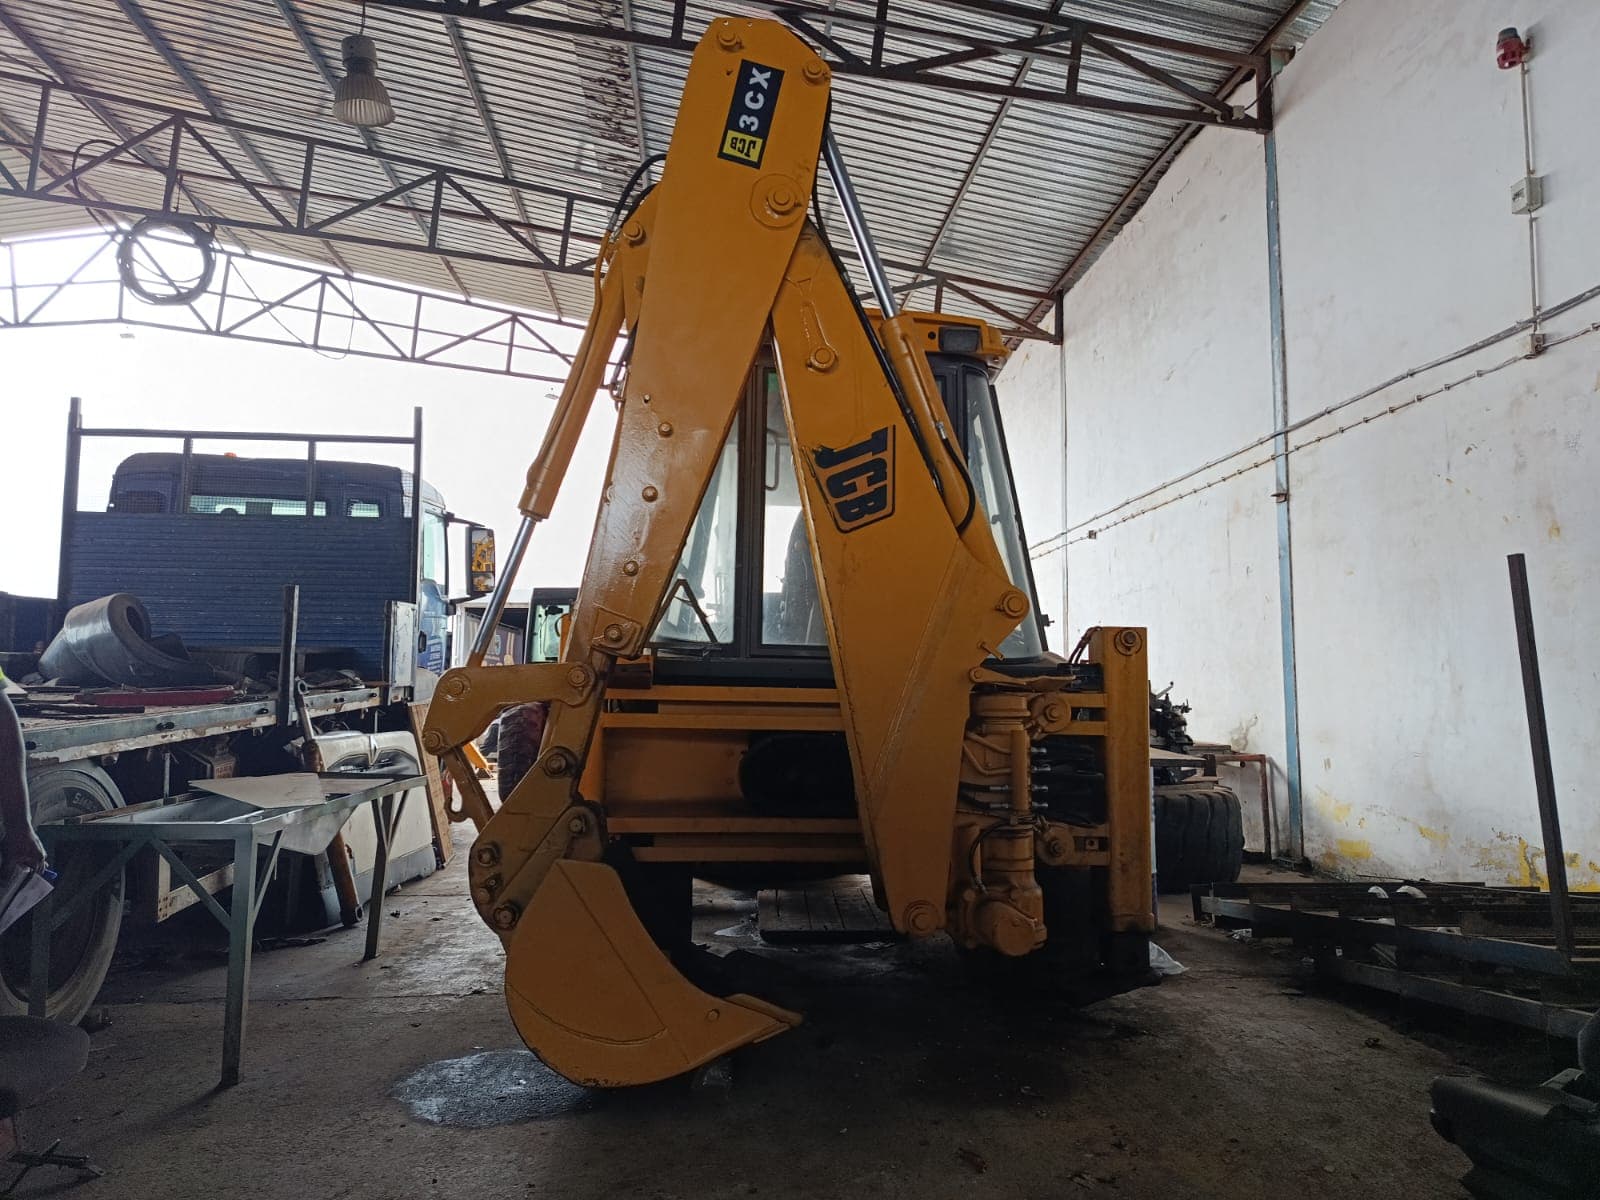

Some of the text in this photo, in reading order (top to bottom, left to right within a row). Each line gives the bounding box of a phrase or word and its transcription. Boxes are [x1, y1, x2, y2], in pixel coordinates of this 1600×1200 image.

[739, 67, 771, 131] 3CX
[730, 136, 756, 157] JCB
[813, 426, 888, 522] JCB
